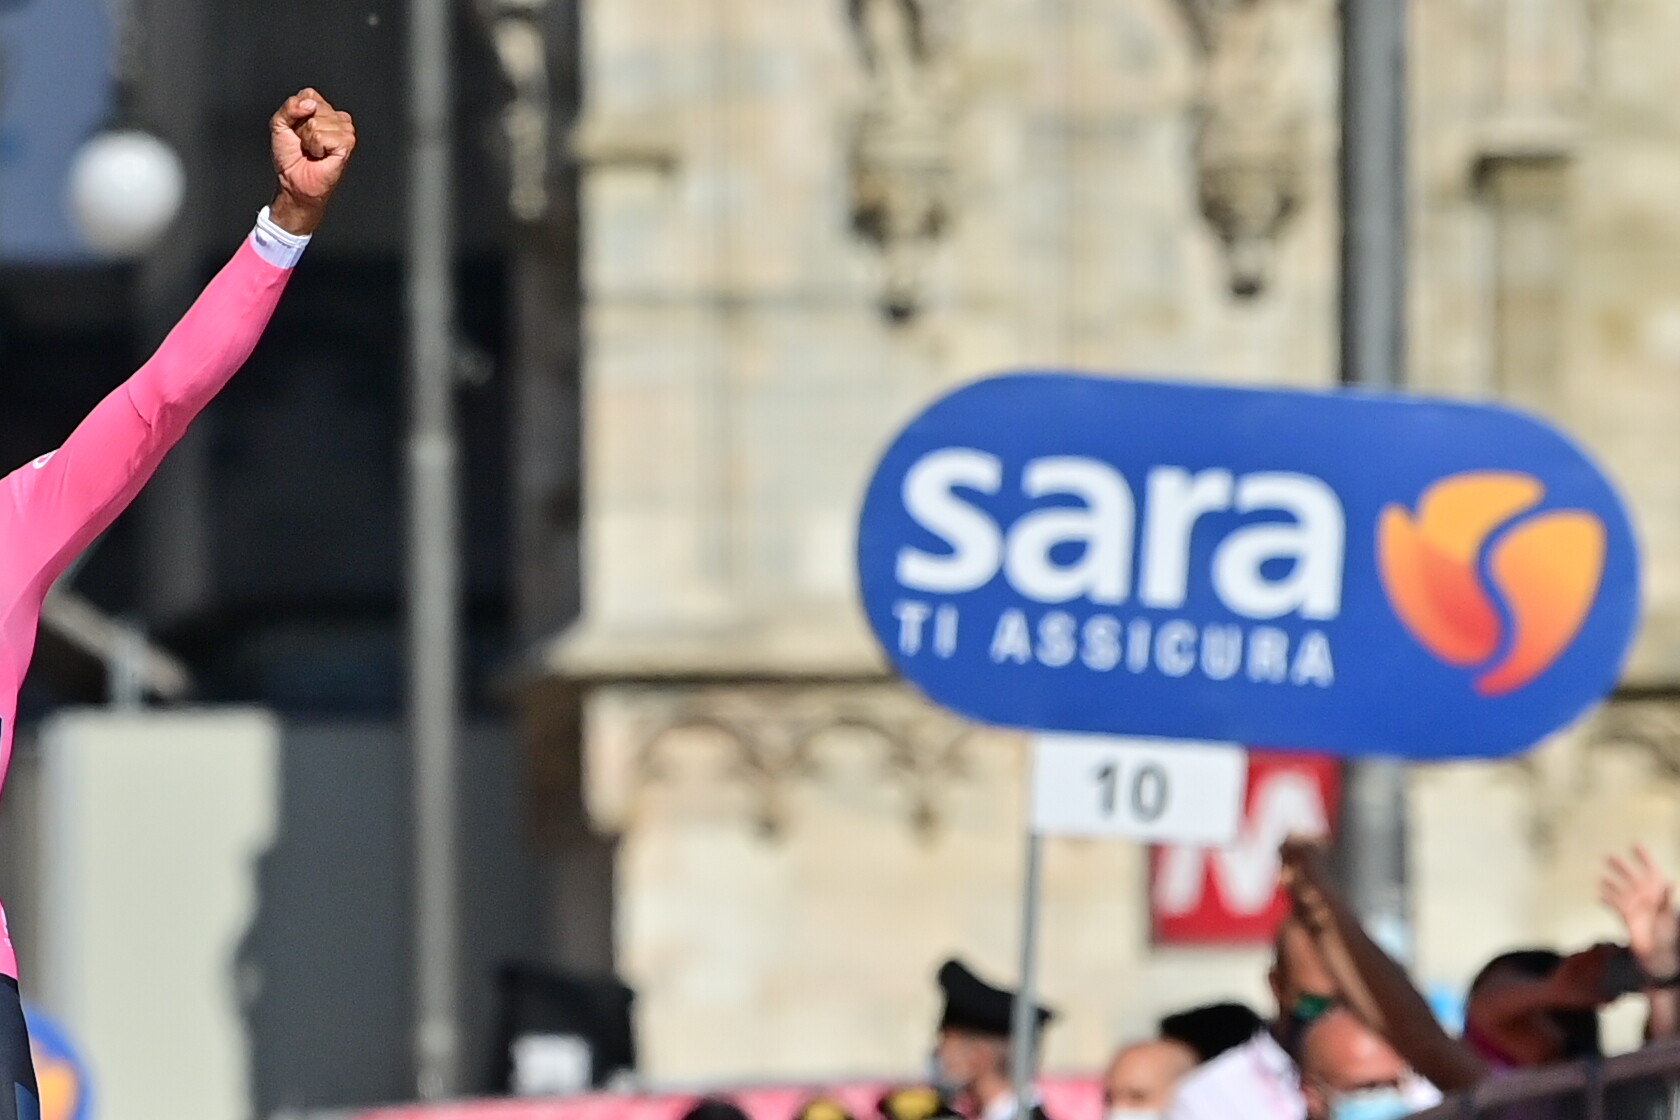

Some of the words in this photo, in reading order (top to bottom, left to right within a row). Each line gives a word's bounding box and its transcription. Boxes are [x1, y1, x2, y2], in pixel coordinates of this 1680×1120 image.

[893, 445, 1347, 620] sara
[891, 602, 961, 659] TI
[990, 606, 1336, 690] ASSICURA
[1092, 762, 1170, 824] 10
